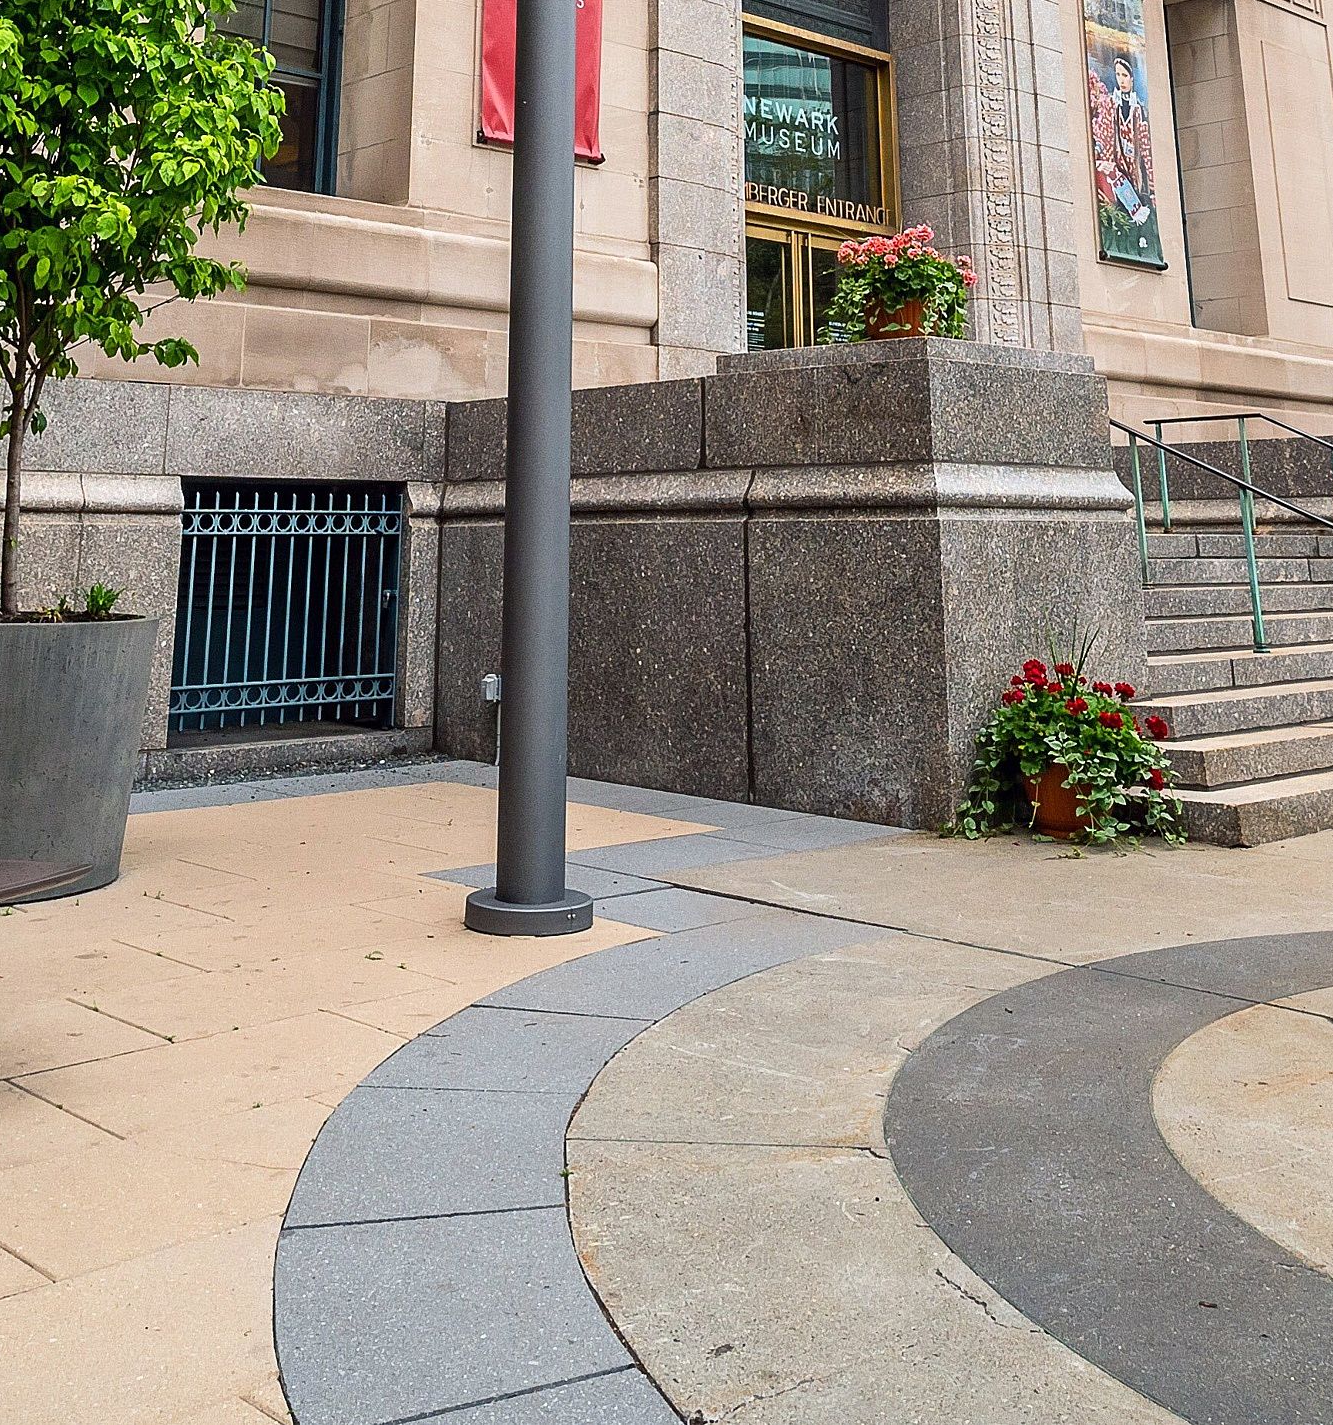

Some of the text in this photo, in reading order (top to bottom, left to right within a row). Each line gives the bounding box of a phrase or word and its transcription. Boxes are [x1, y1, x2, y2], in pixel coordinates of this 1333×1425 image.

[743, 94, 839, 135] NEWARK
[744, 120, 841, 160] MUSEUM
[817, 195, 891, 226] ENTRANCE
